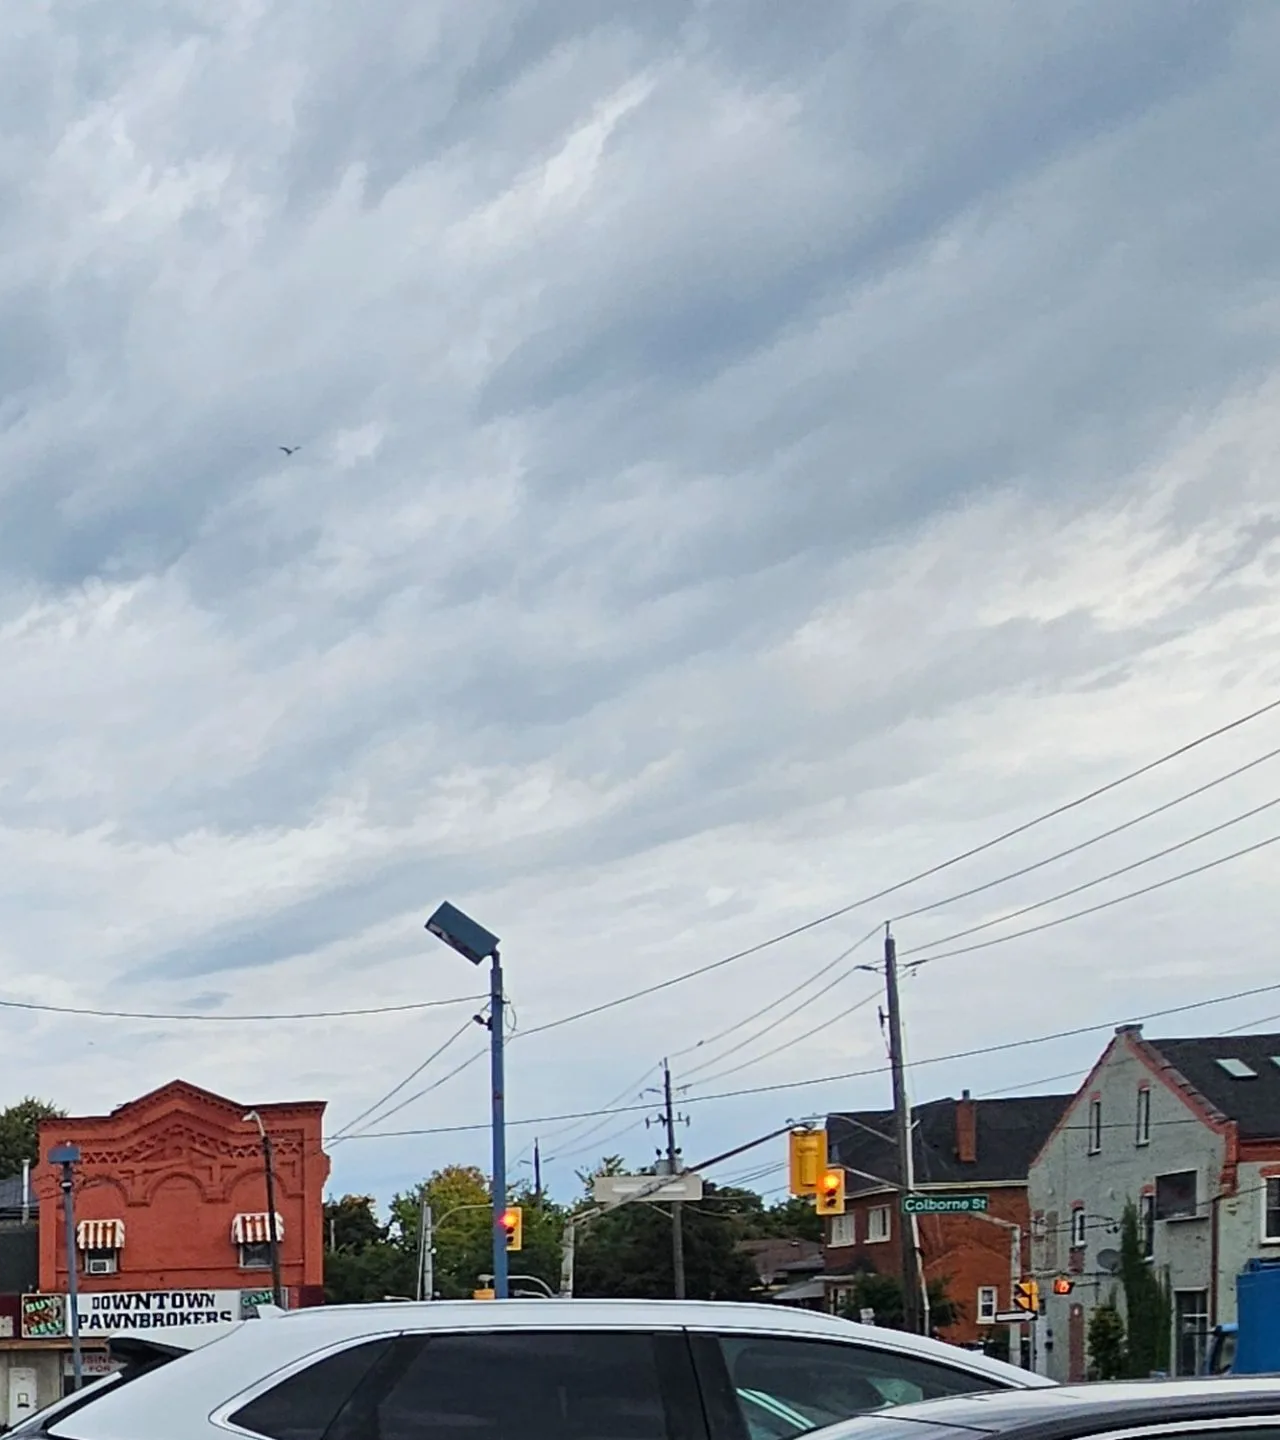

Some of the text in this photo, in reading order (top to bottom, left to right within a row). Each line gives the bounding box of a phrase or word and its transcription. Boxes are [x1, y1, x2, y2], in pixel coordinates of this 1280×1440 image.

[905, 1198, 986, 1211] Colborne St
[92, 1292, 216, 1311] DOWNTOWN
[242, 1291, 273, 1306] CASH
[78, 1310, 233, 1330] PAWNBROKERS
